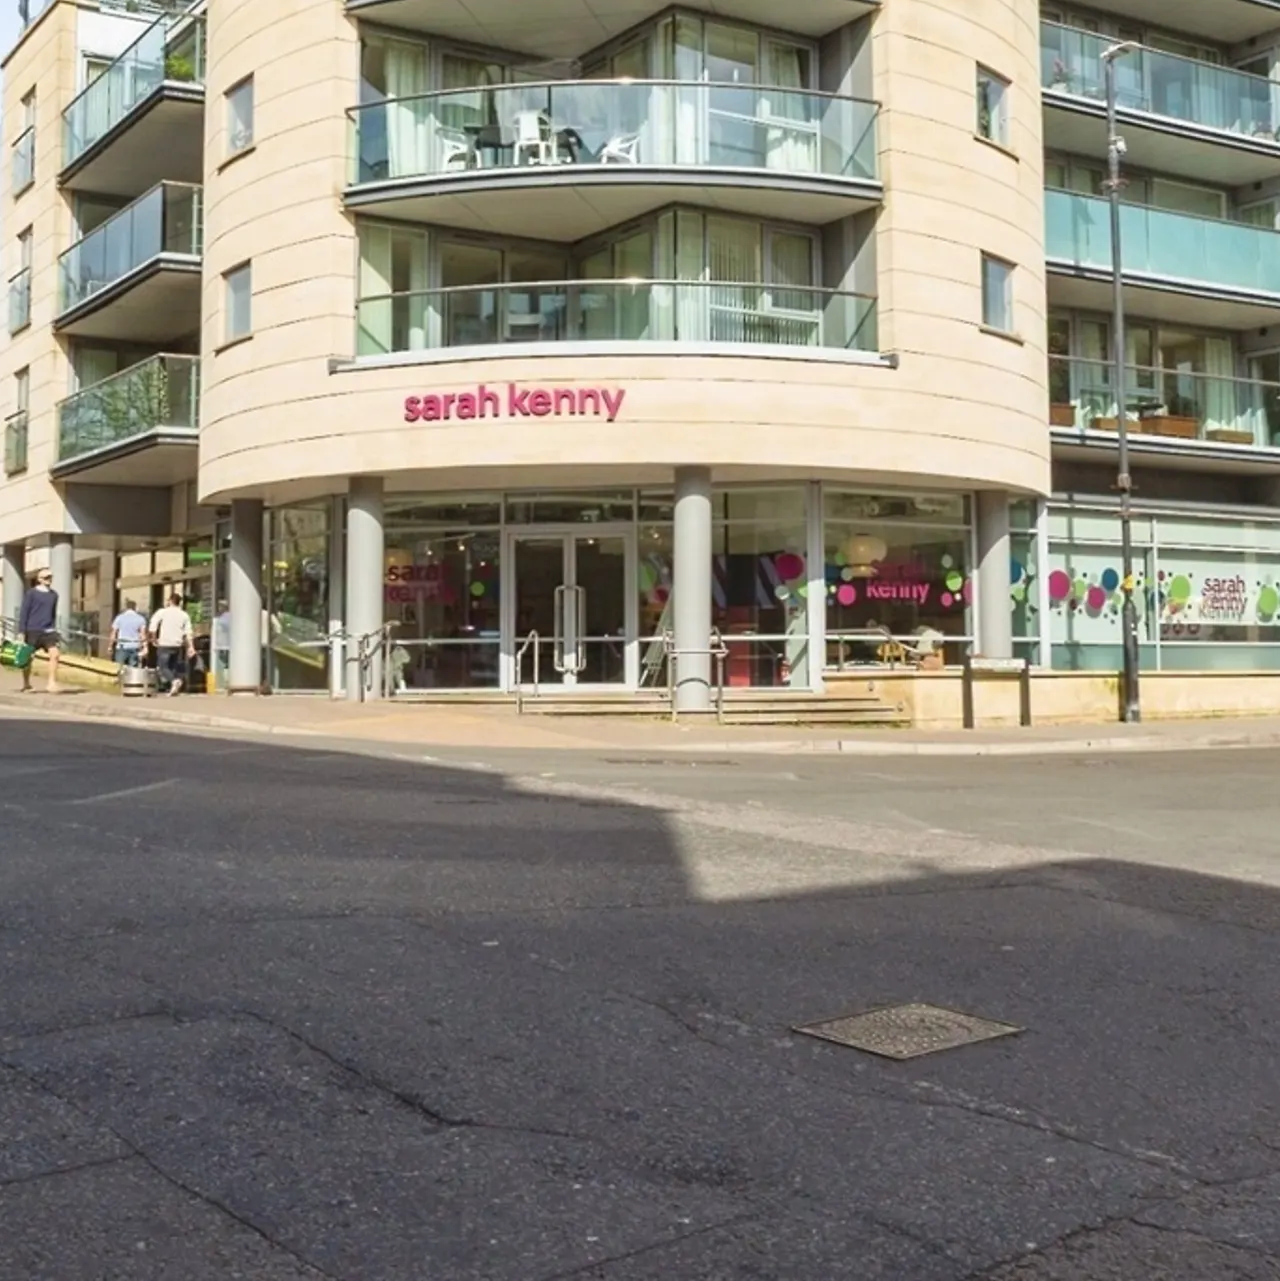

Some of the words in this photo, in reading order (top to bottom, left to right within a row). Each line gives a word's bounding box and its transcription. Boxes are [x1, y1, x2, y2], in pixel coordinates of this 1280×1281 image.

[404, 385, 499, 422] sarah
[508, 383, 626, 422] kenny
[1203, 575, 1246, 593] sarah
